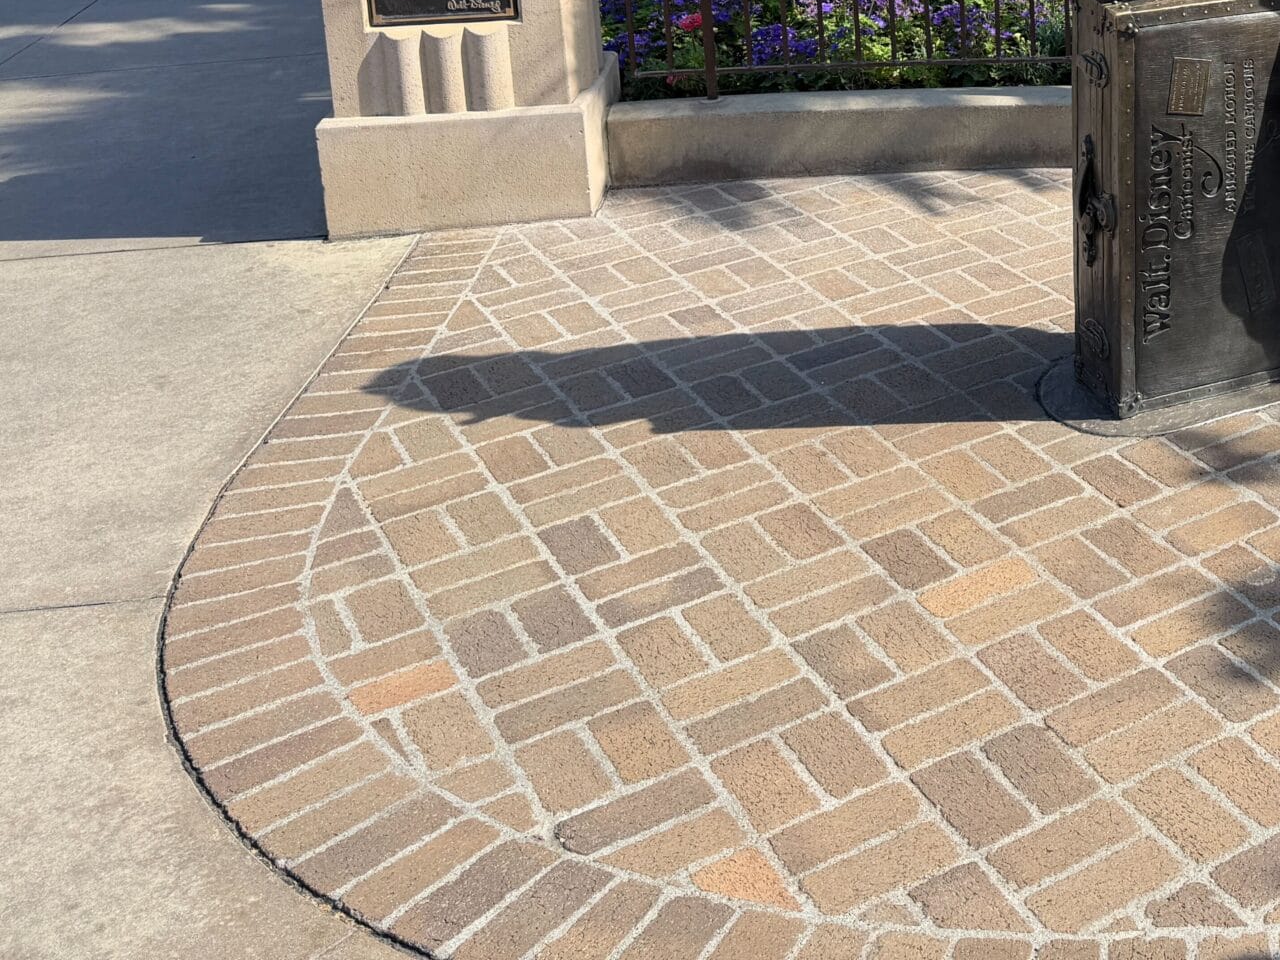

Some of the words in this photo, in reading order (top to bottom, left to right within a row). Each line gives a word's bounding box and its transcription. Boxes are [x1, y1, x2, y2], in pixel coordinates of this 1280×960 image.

[1223, 62, 1236, 125] MOTION
[1243, 58, 1256, 139] CARTOONS
[1138, 124, 1190, 251] Disney
[1173, 124, 1194, 240] Cartoonist
[1224, 130, 1237, 214] ANIMATED
